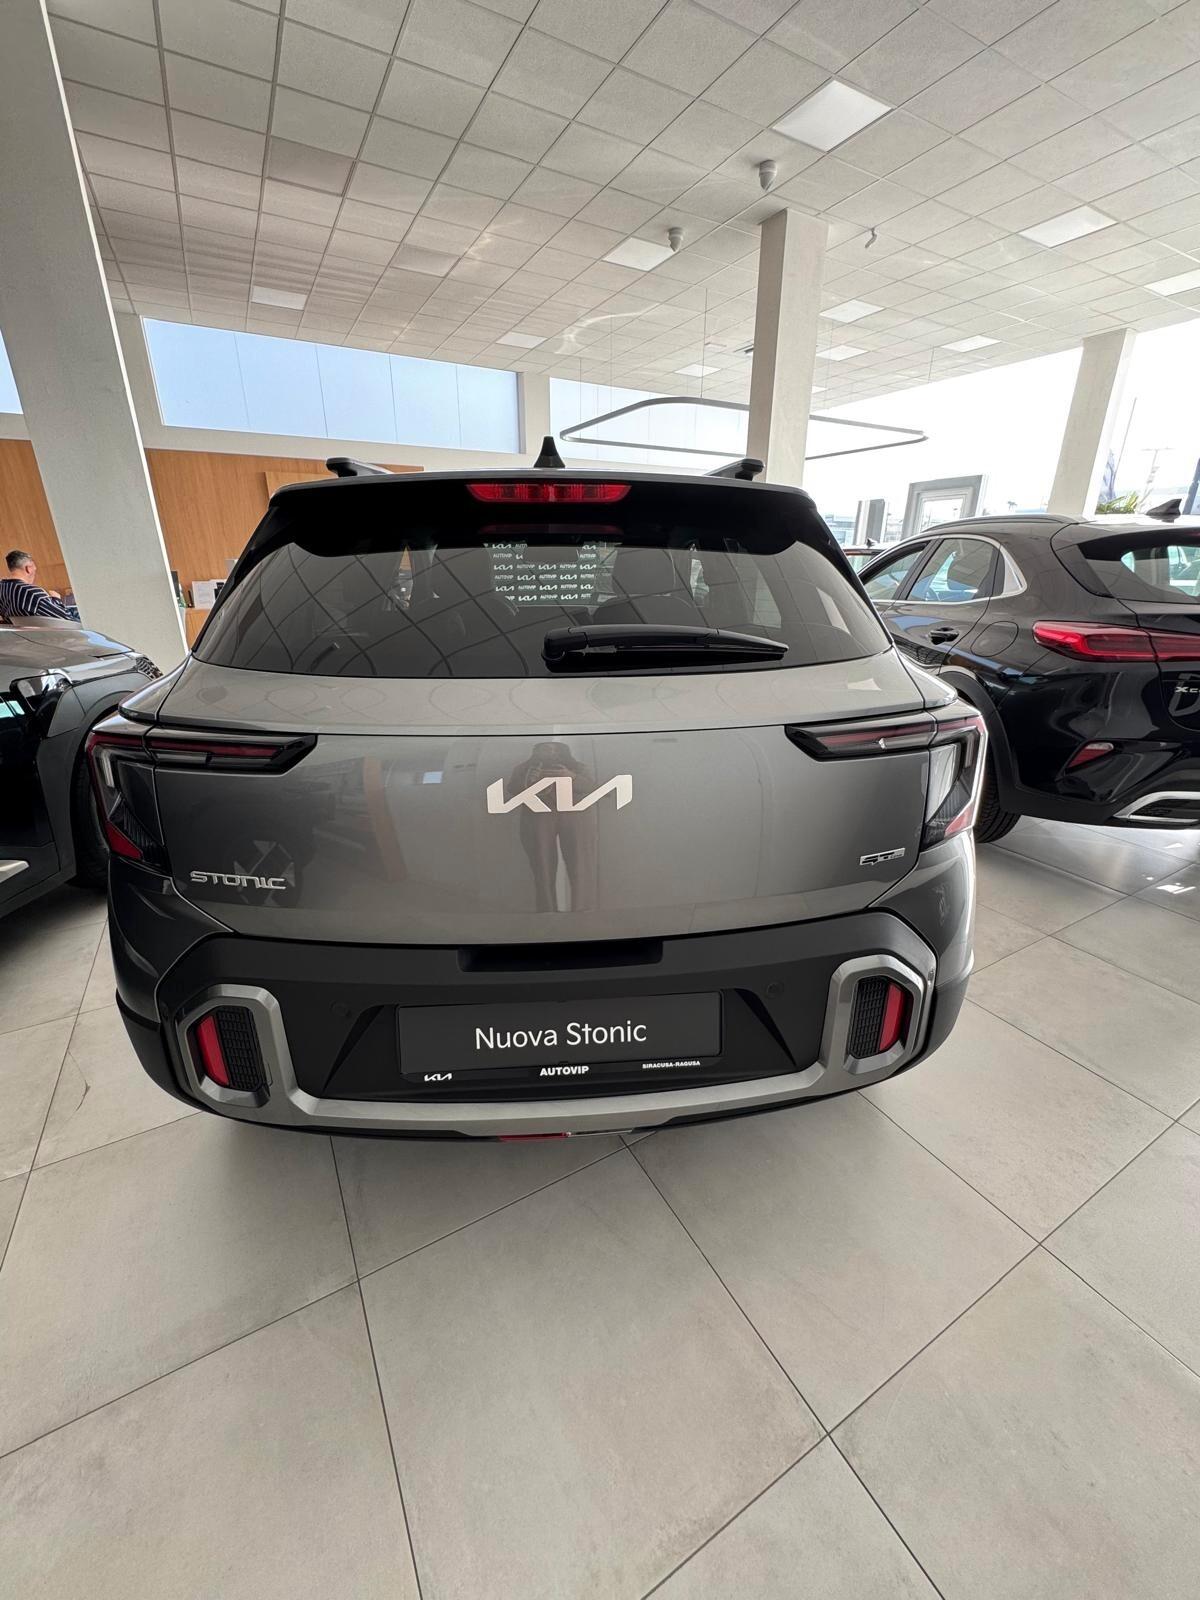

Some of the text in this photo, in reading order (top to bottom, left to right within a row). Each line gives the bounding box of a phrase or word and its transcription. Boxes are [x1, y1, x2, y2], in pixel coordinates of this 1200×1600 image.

[486, 774, 633, 814] KIA
[190, 870, 287, 890] STONIC
[475, 1020, 648, 1050] Nuova Stonic
[539, 1065, 590, 1077] AUTOVIP
[642, 1060, 701, 1070] SIRACUSA-RAGUSA
[424, 1072, 453, 1082] KIA
